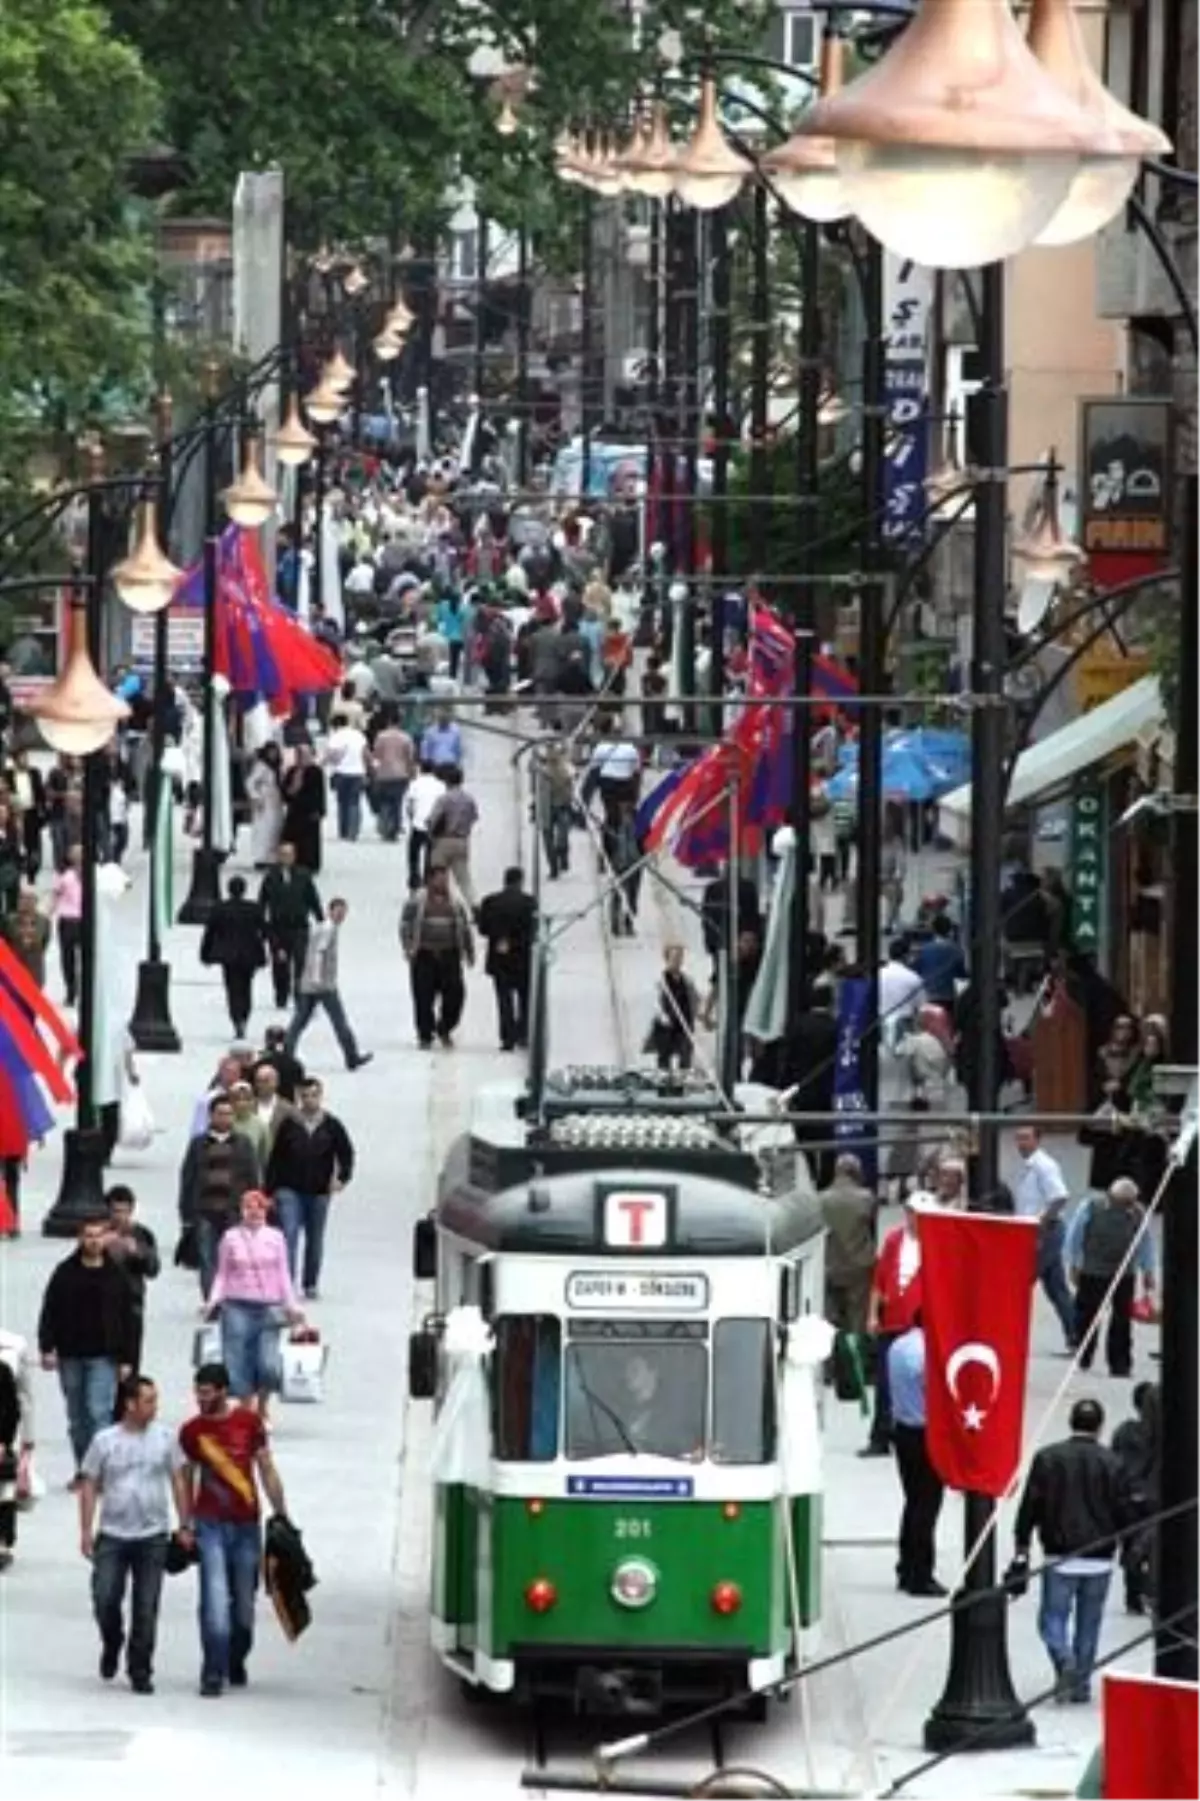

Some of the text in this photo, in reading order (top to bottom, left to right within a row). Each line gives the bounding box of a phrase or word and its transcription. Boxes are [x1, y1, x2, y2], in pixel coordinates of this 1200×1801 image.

[1075, 796, 1098, 937] OKANTA
[617, 1200, 656, 1247] T
[614, 1518, 652, 1538] 201
